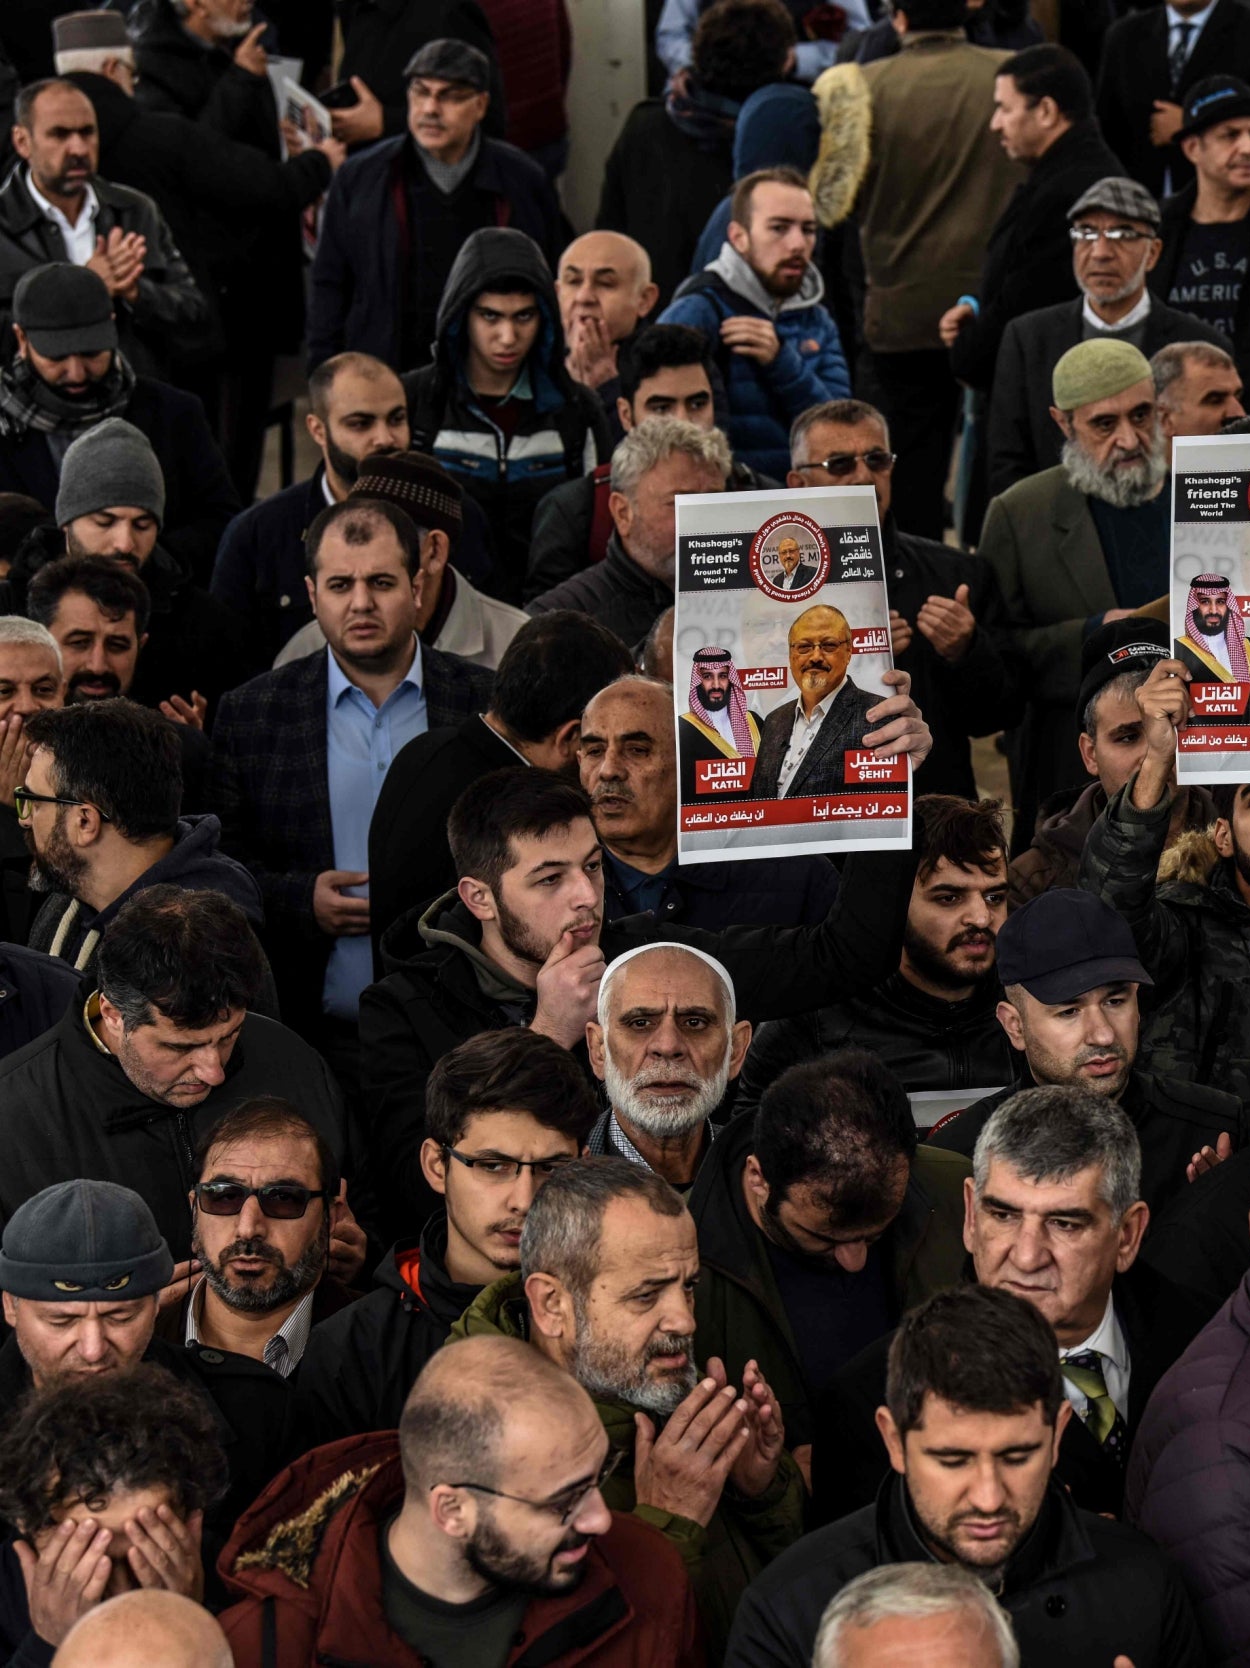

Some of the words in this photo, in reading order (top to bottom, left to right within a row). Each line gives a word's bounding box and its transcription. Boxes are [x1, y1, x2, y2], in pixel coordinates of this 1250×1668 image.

[1168, 283, 1243, 303] AMERIC
[1186, 488, 1238, 499] friends
[840, 528, 870, 544] أصدقاء
[688, 538, 742, 548] Khashoggi's
[690, 552, 740, 564] friends
[840, 546, 872, 566] خاشقجي
[694, 568, 722, 576] Around
[842, 568, 862, 579] العالم
[862, 568, 874, 578] حول
[852, 630, 888, 653] الغائب
[743, 668, 784, 685] الحاضر
[1194, 686, 1242, 704] القاتل
[1206, 704, 1238, 712] KATIL
[1182, 734, 1206, 748] العقاب
[1208, 735, 1222, 746] من
[1224, 734, 1248, 747] يفلت
[700, 762, 746, 780] القاتل
[858, 768, 892, 781] ŞEHİT
[712, 780, 744, 790] KATIL
[754, 809, 764, 820] لن
[832, 804, 862, 818] يجف
[866, 802, 878, 816] لن
[882, 805, 902, 815] دم
[685, 812, 712, 828] العقاب
[714, 813, 728, 824] من
[730, 810, 752, 822] يفلت
